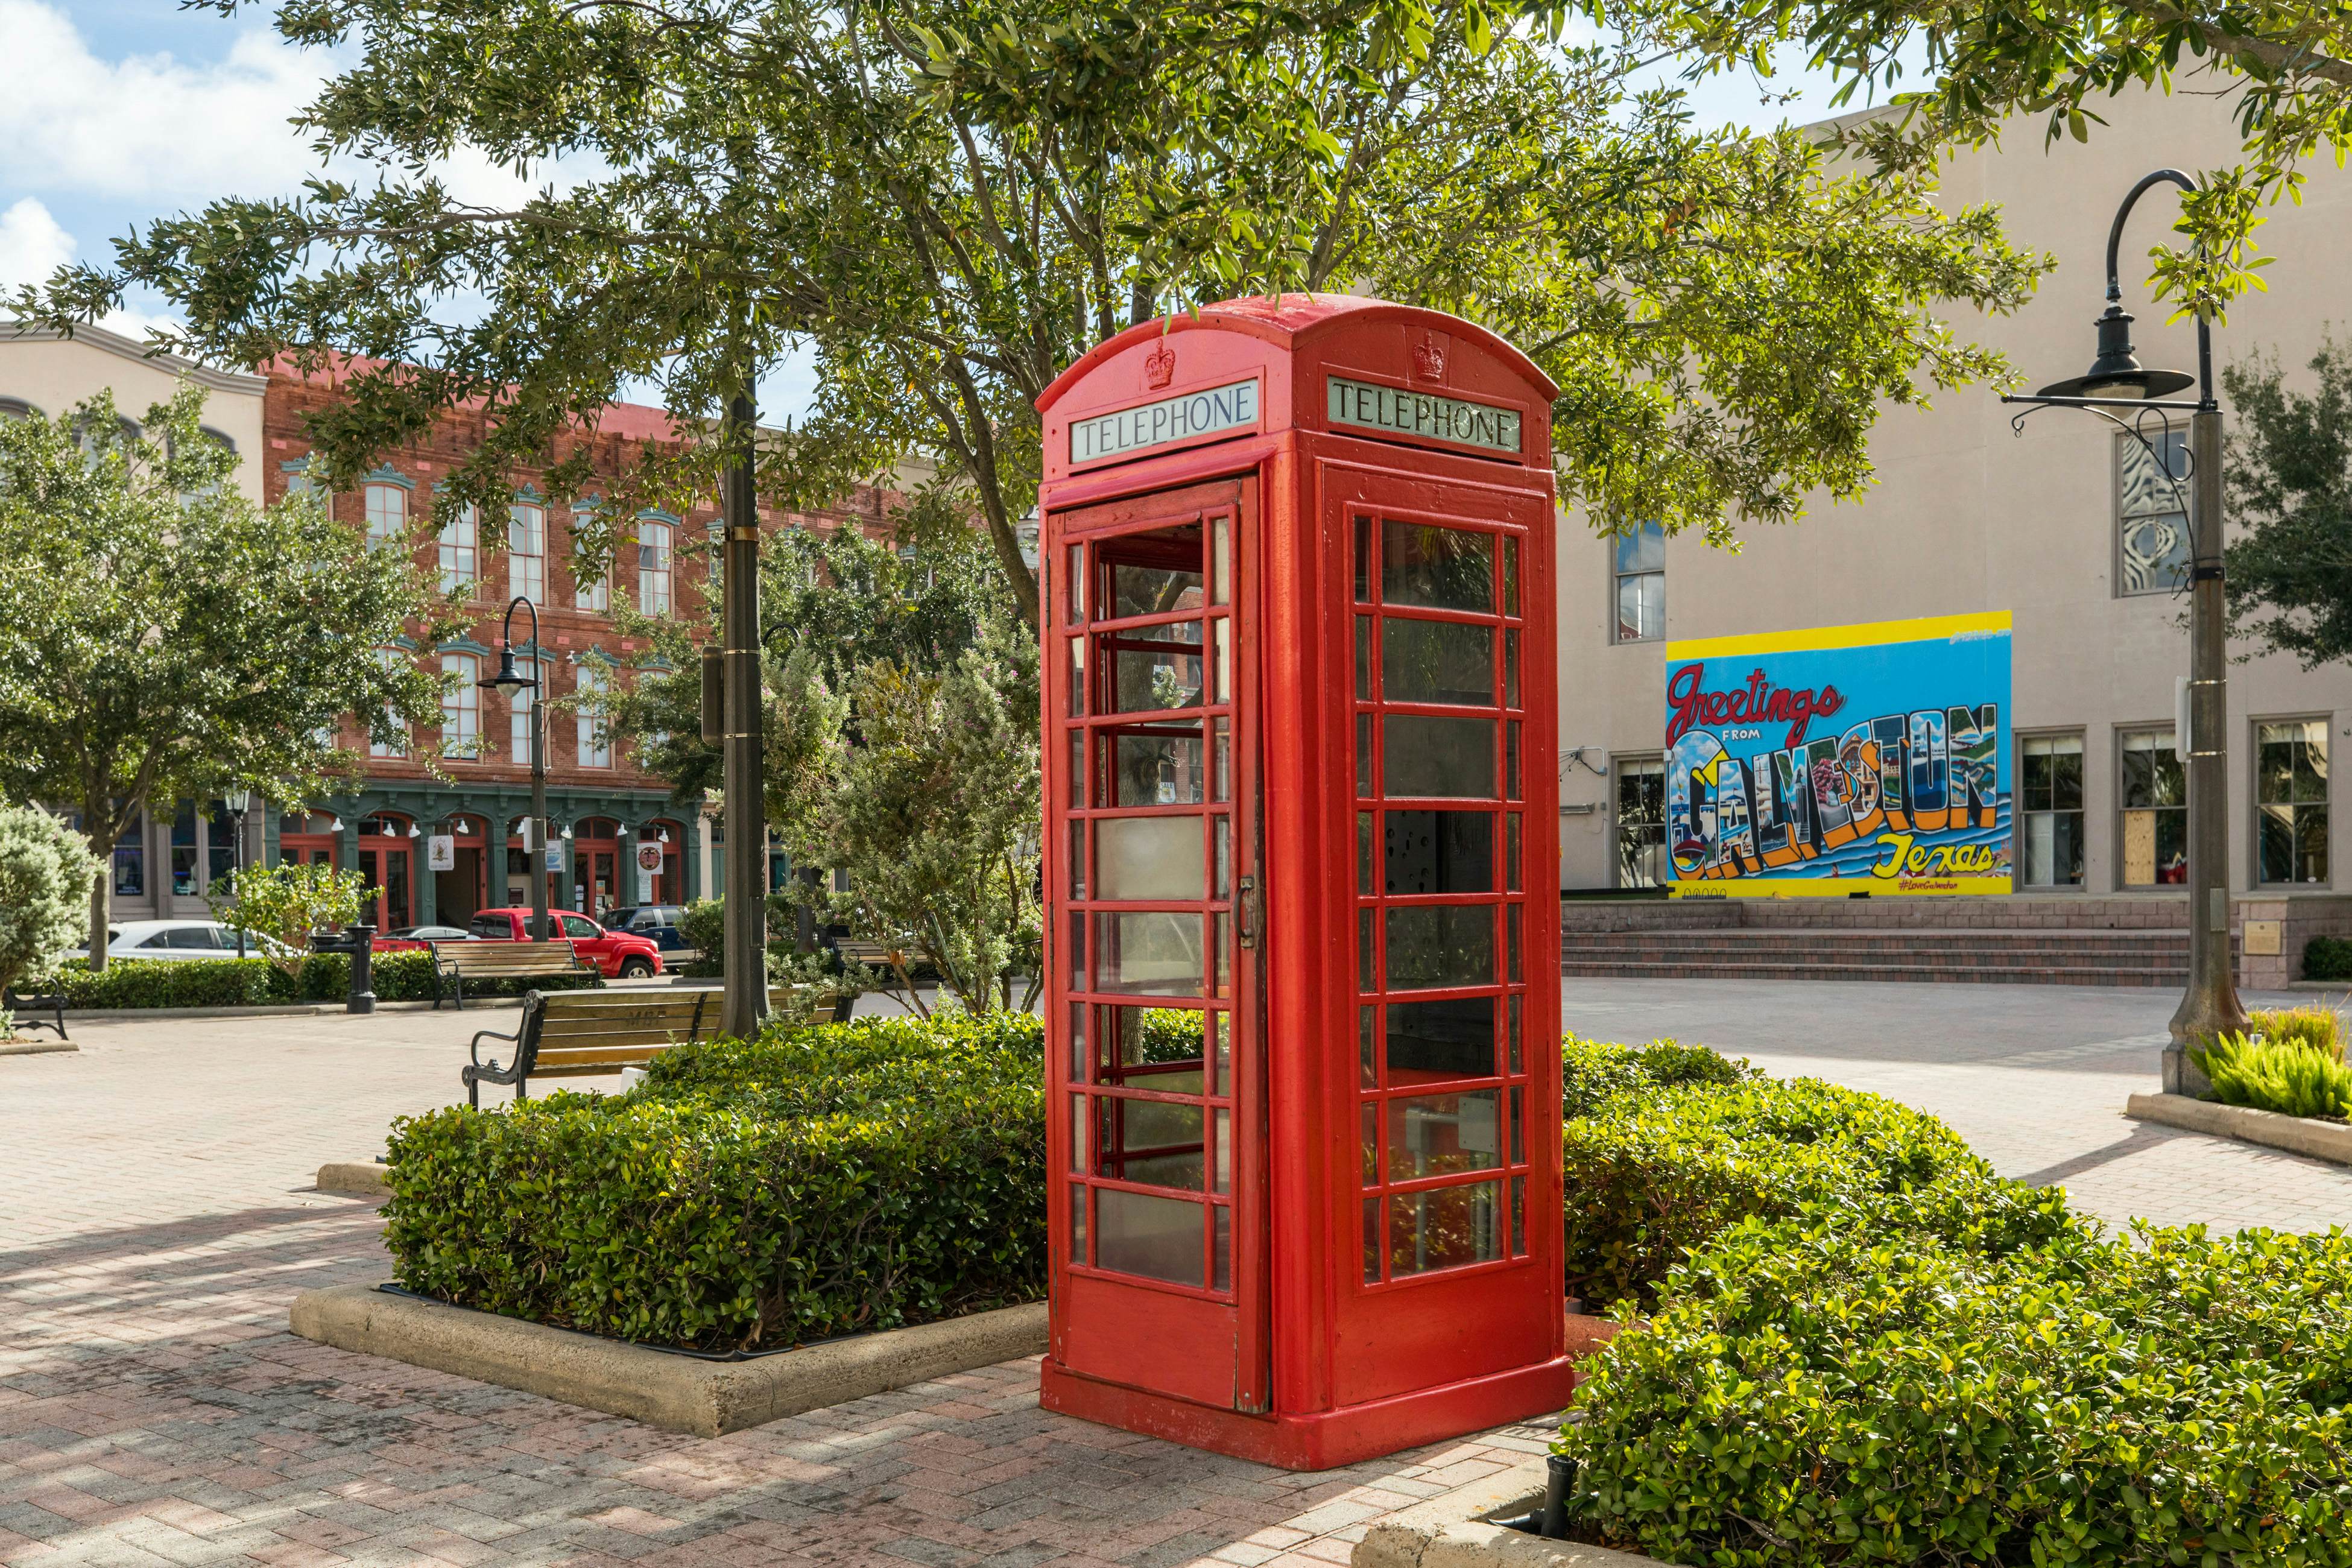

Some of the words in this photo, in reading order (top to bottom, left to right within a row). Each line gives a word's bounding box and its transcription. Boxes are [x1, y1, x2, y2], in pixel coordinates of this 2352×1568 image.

[1080, 385, 1252, 456] TELEPHONE
[1332, 382, 1512, 447] TELEPHONE
[1666, 662, 1844, 750] Greetings
[1722, 729, 1761, 742] FROM
[1667, 703, 1999, 880] GALVESTON
[1871, 832, 1997, 879] Texas
[1898, 879, 1958, 891] #LoveGalveston
